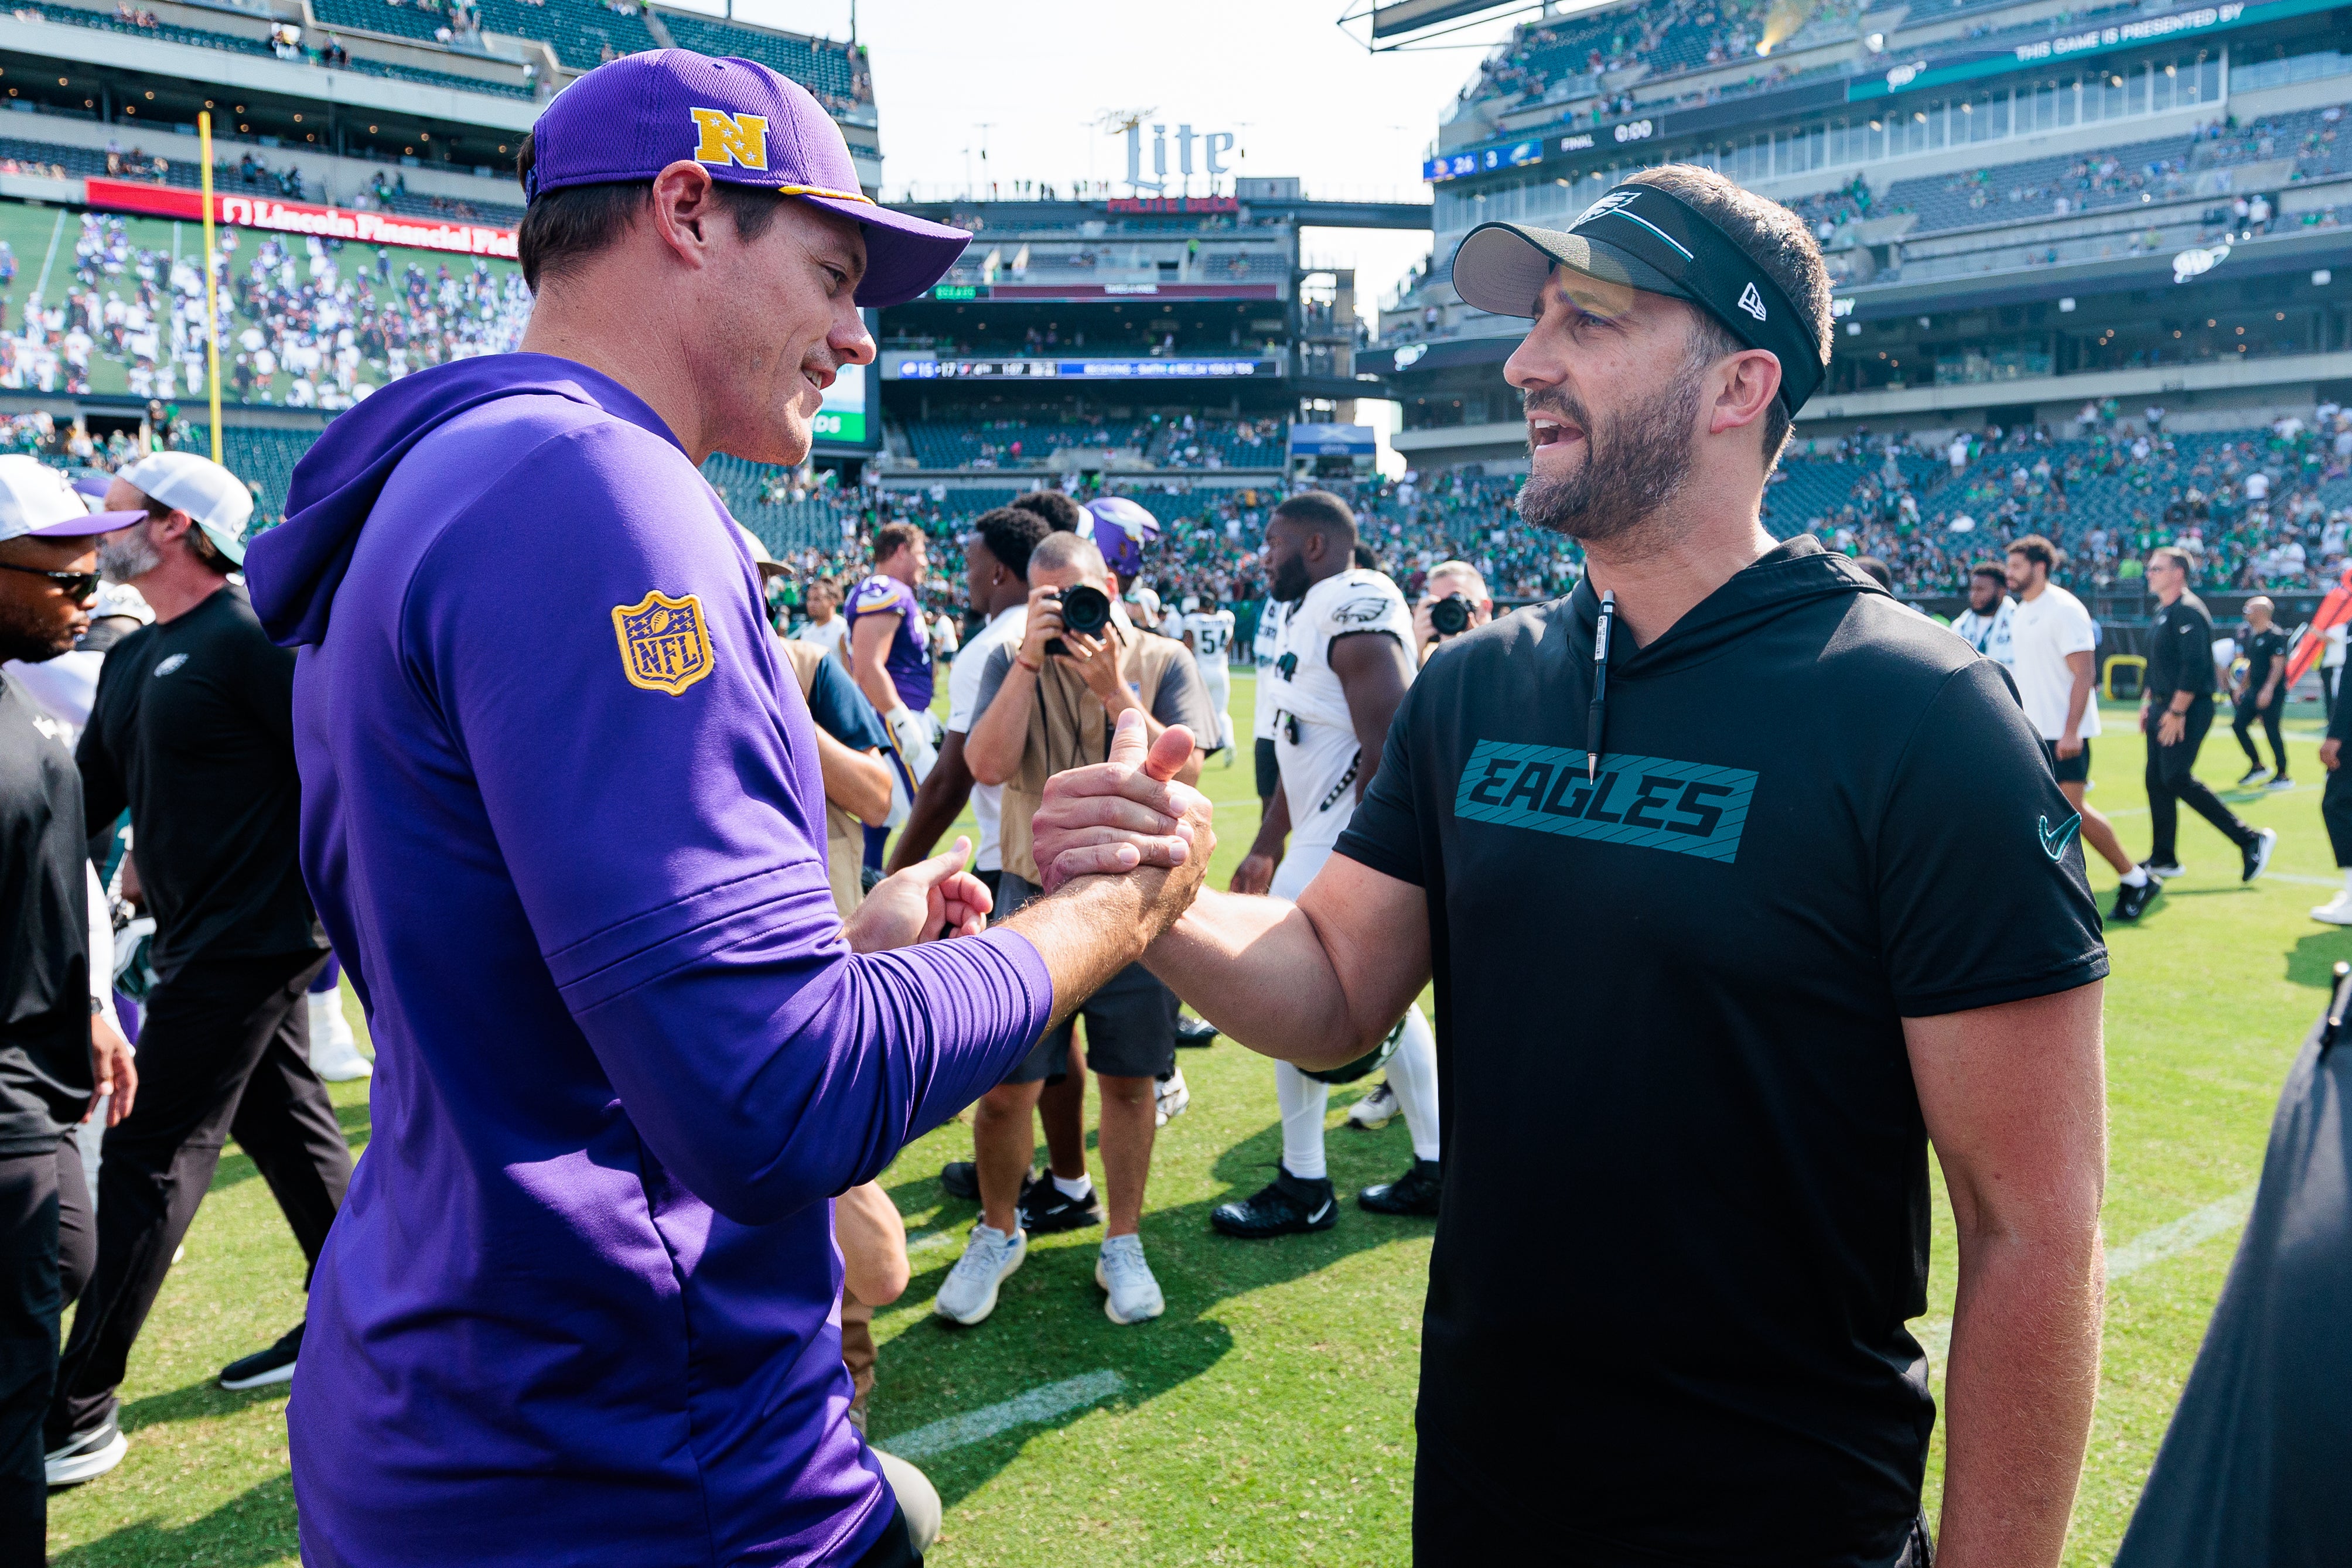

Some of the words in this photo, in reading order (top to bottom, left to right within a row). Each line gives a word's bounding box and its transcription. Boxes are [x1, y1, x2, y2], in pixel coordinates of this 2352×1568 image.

[2016, 41, 2051, 62] THIS
[2052, 31, 2100, 54] GAME
[2101, 28, 2119, 45] IS
[2120, 8, 2217, 41] PRESENTED
[2218, 2, 2244, 23] BY
[690, 107, 769, 170] N
[1124, 122, 1233, 191] Lite
[1486, 150, 1497, 168] 3
[1561, 134, 1594, 152] FINAL
[1614, 119, 1653, 143] 0:00
[252, 201, 356, 238] Lincoln
[356, 213, 472, 252] Financial
[473, 228, 518, 257] Fiel
[636, 635, 698, 675] NFL
[1469, 758, 1735, 838] EAGLES
